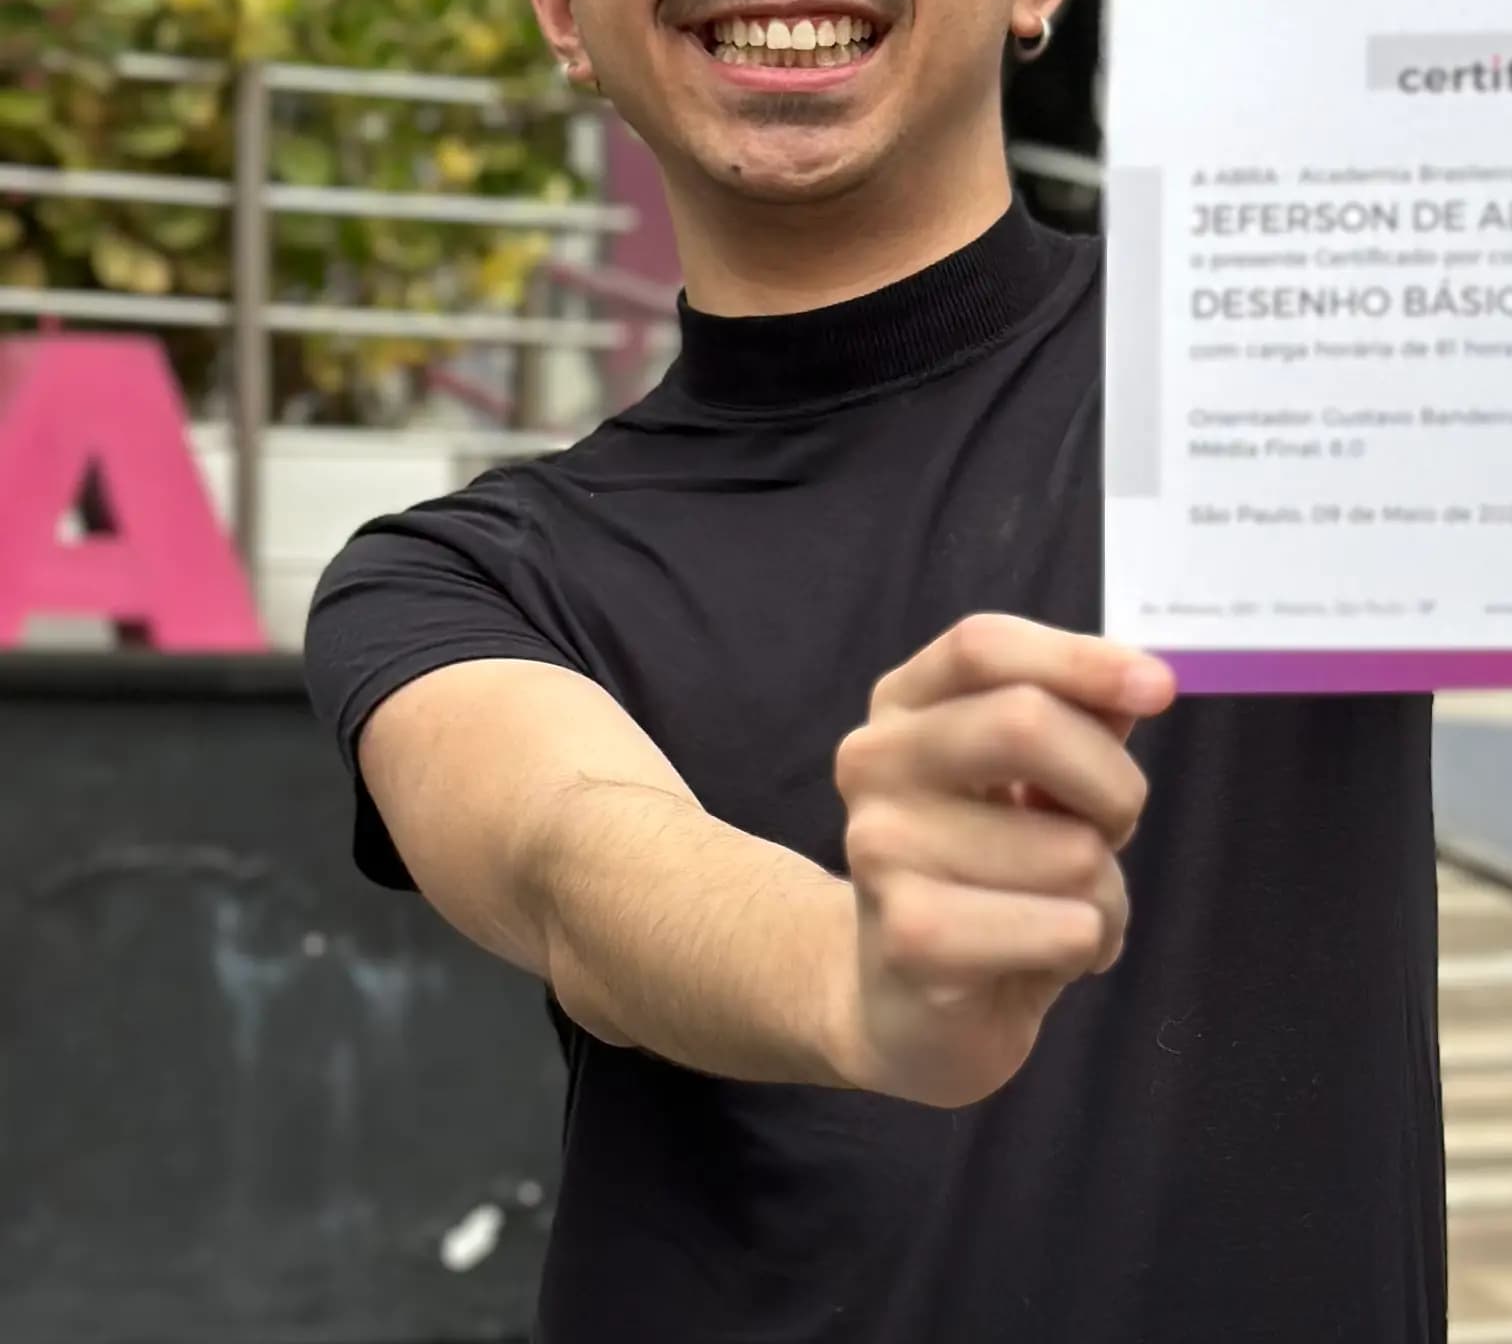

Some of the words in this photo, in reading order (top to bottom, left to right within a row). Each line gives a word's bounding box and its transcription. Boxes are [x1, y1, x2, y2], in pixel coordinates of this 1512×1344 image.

[1189, 200, 1399, 236] JEFERSON
[1411, 199, 1466, 233] DE
[1190, 284, 1393, 321] DESENHO
[1347, 505, 1376, 524] de
[1442, 505, 1472, 524] de
